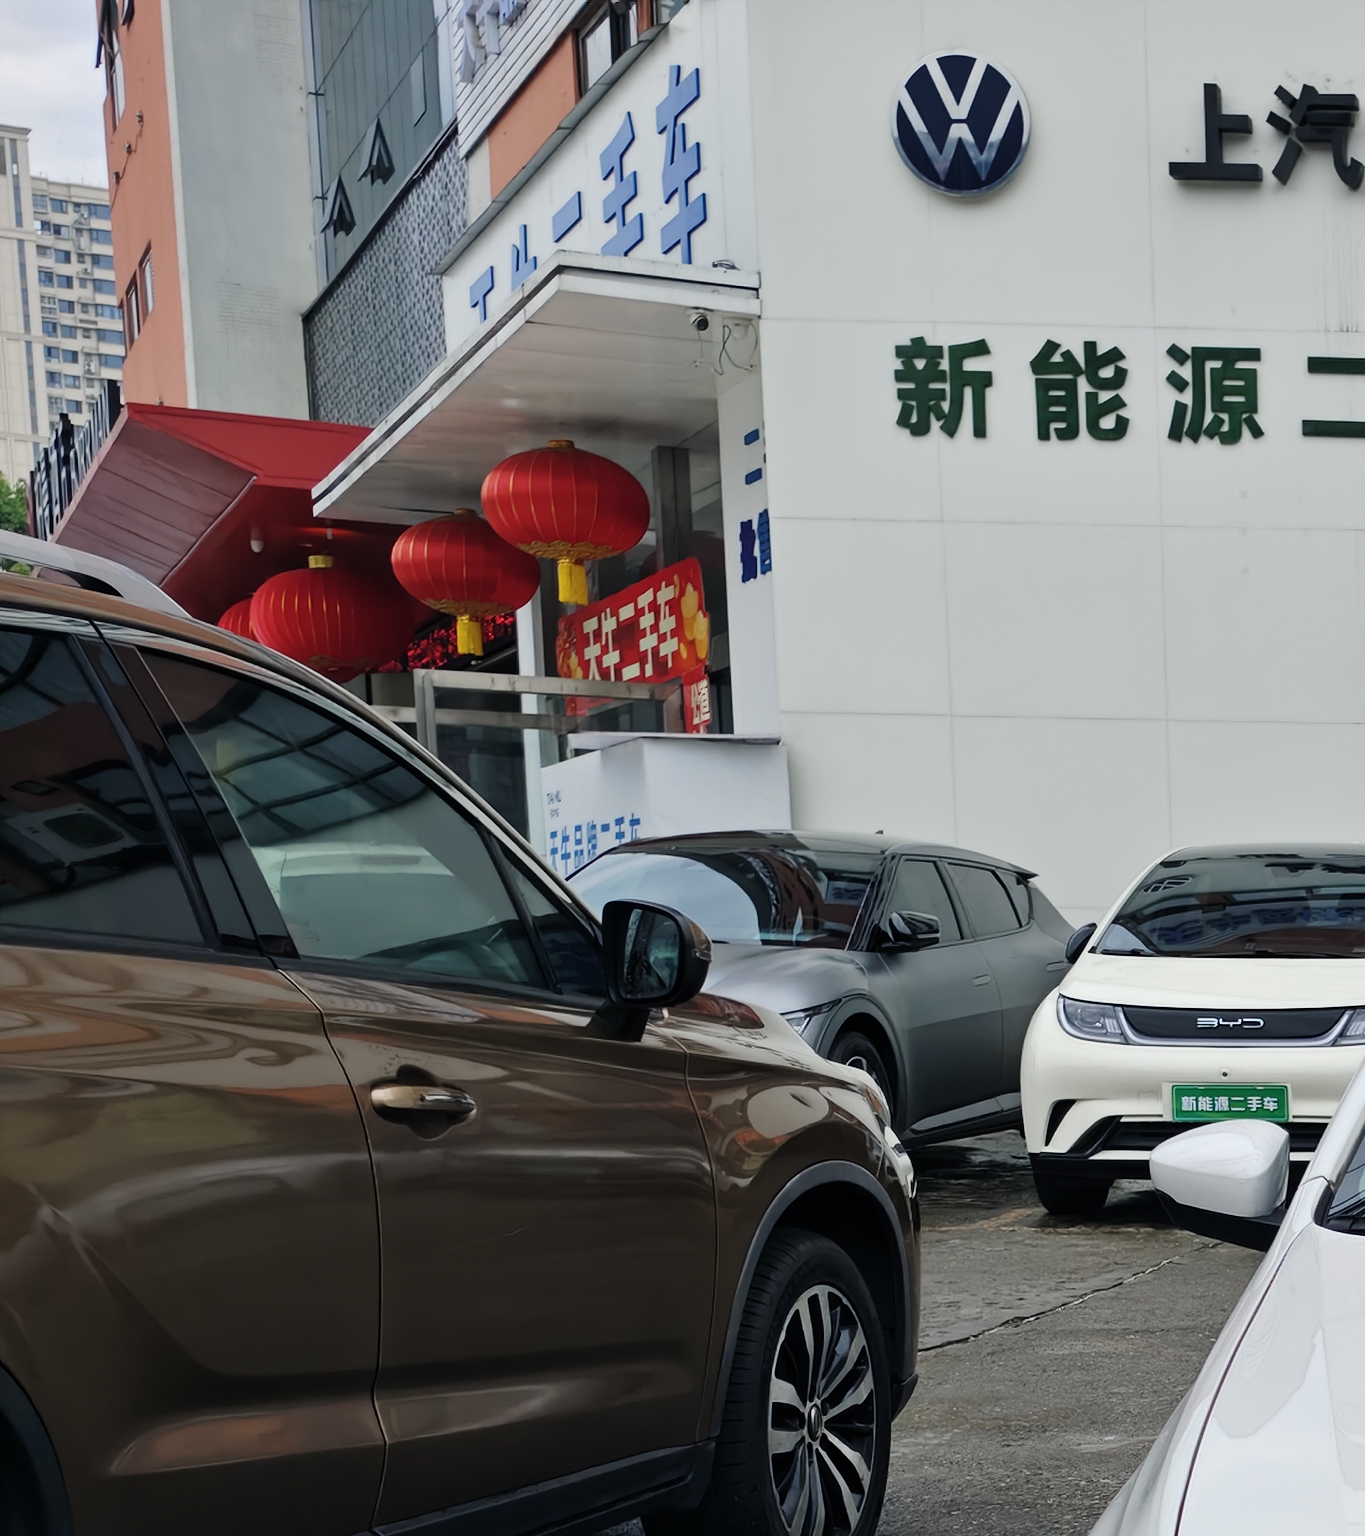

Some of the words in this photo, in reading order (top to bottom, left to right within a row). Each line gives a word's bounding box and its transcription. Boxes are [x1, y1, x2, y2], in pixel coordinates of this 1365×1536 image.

[583, 580, 679, 682] 天牛二手车
[1196, 1017, 1265, 1029] BYD
[1181, 1095, 1279, 1112] 新能源二手车
